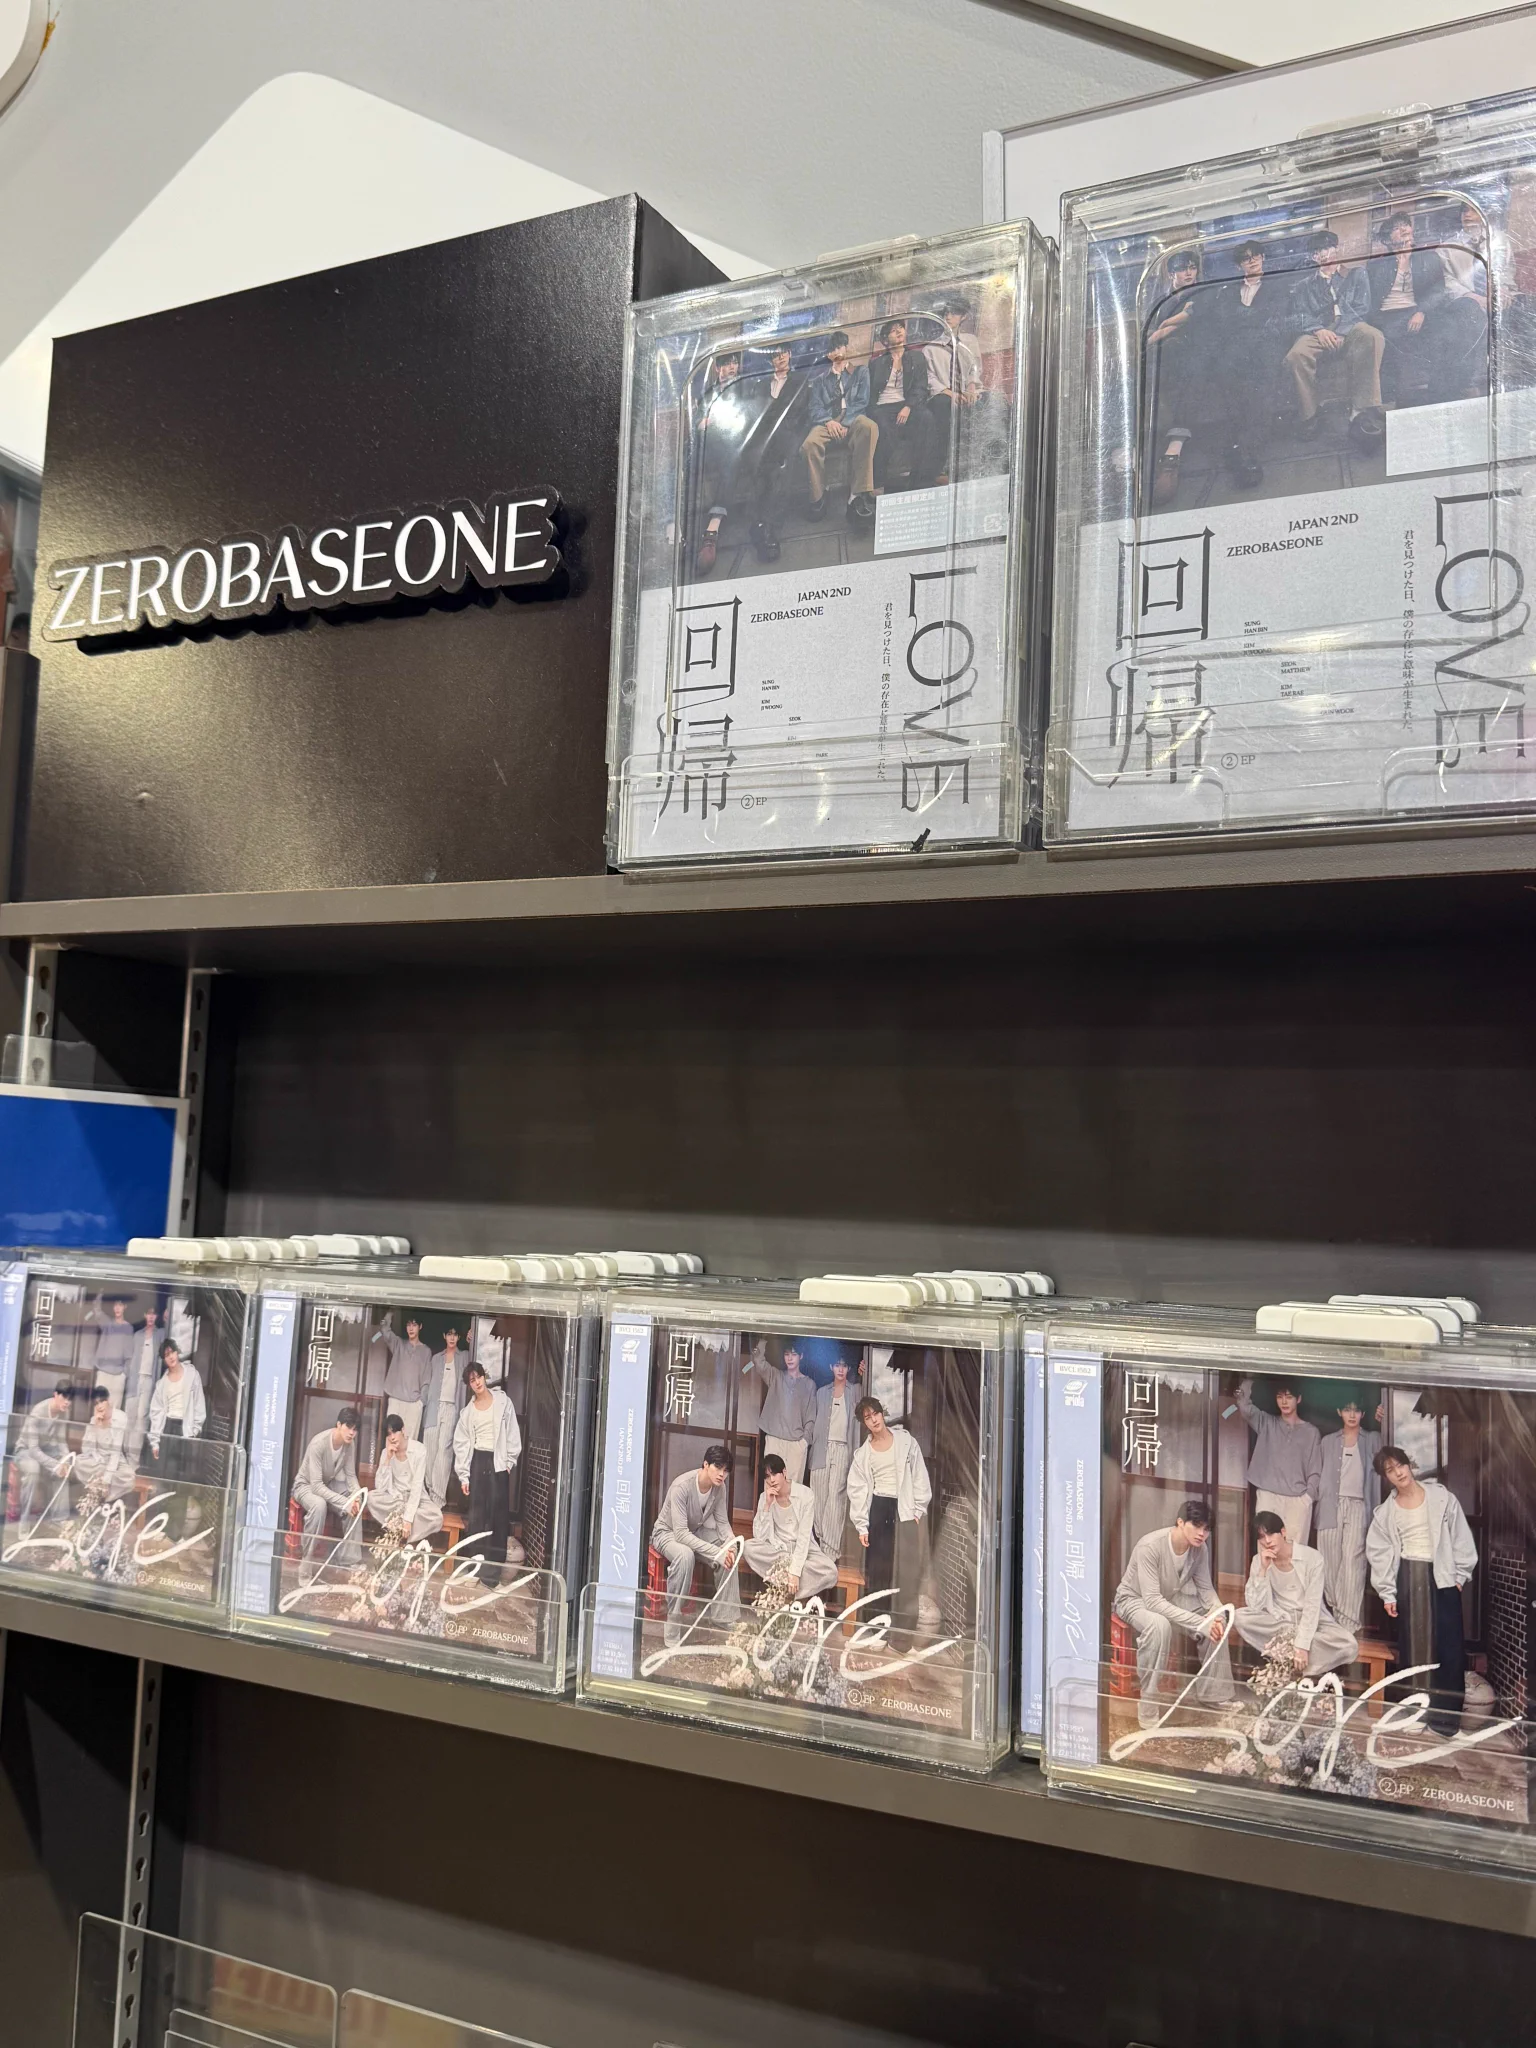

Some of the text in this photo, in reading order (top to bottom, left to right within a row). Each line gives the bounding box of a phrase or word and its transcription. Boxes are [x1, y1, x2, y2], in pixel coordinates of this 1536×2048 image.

[1226, 535, 1323, 558] ZEROBASEONE
[1288, 512, 1359, 533] JAPAN 2ND
[50, 497, 548, 631] ZEROBASEONE
[750, 605, 824, 624] ZEROBASEONE
[797, 585, 852, 604] JAPAN 2ND
[1434, 487, 1531, 769] LOVE
[900, 564, 978, 813] LOVE
[1281, 666, 1312, 675] MATTHEW
[306, 1306, 335, 1385] 回帰
[664, 1332, 696, 1419] 回帰
[626, 1408, 634, 1463] ZEROBASEONE
[1123, 1370, 1162, 1469] 回帰
[615, 1479, 631, 1514] 回帰
[1065, 1480, 1073, 1536] JAPAN 2ND EP
[1076, 1459, 1084, 1521] ZEROBASEONE
[278, 1487, 539, 1626] Love
[1065, 1539, 1085, 1578] 回帰
[160, 1576, 205, 1593] ZEROBASEONE
[472, 1627, 529, 1645] ZEROBASEONE
[641, 1534, 963, 1691] Love
[881, 1697, 952, 1719] ZEROBASEONE
[1109, 1603, 1523, 1781] Love
[1422, 1787, 1515, 1812] ZEROBASEONE
